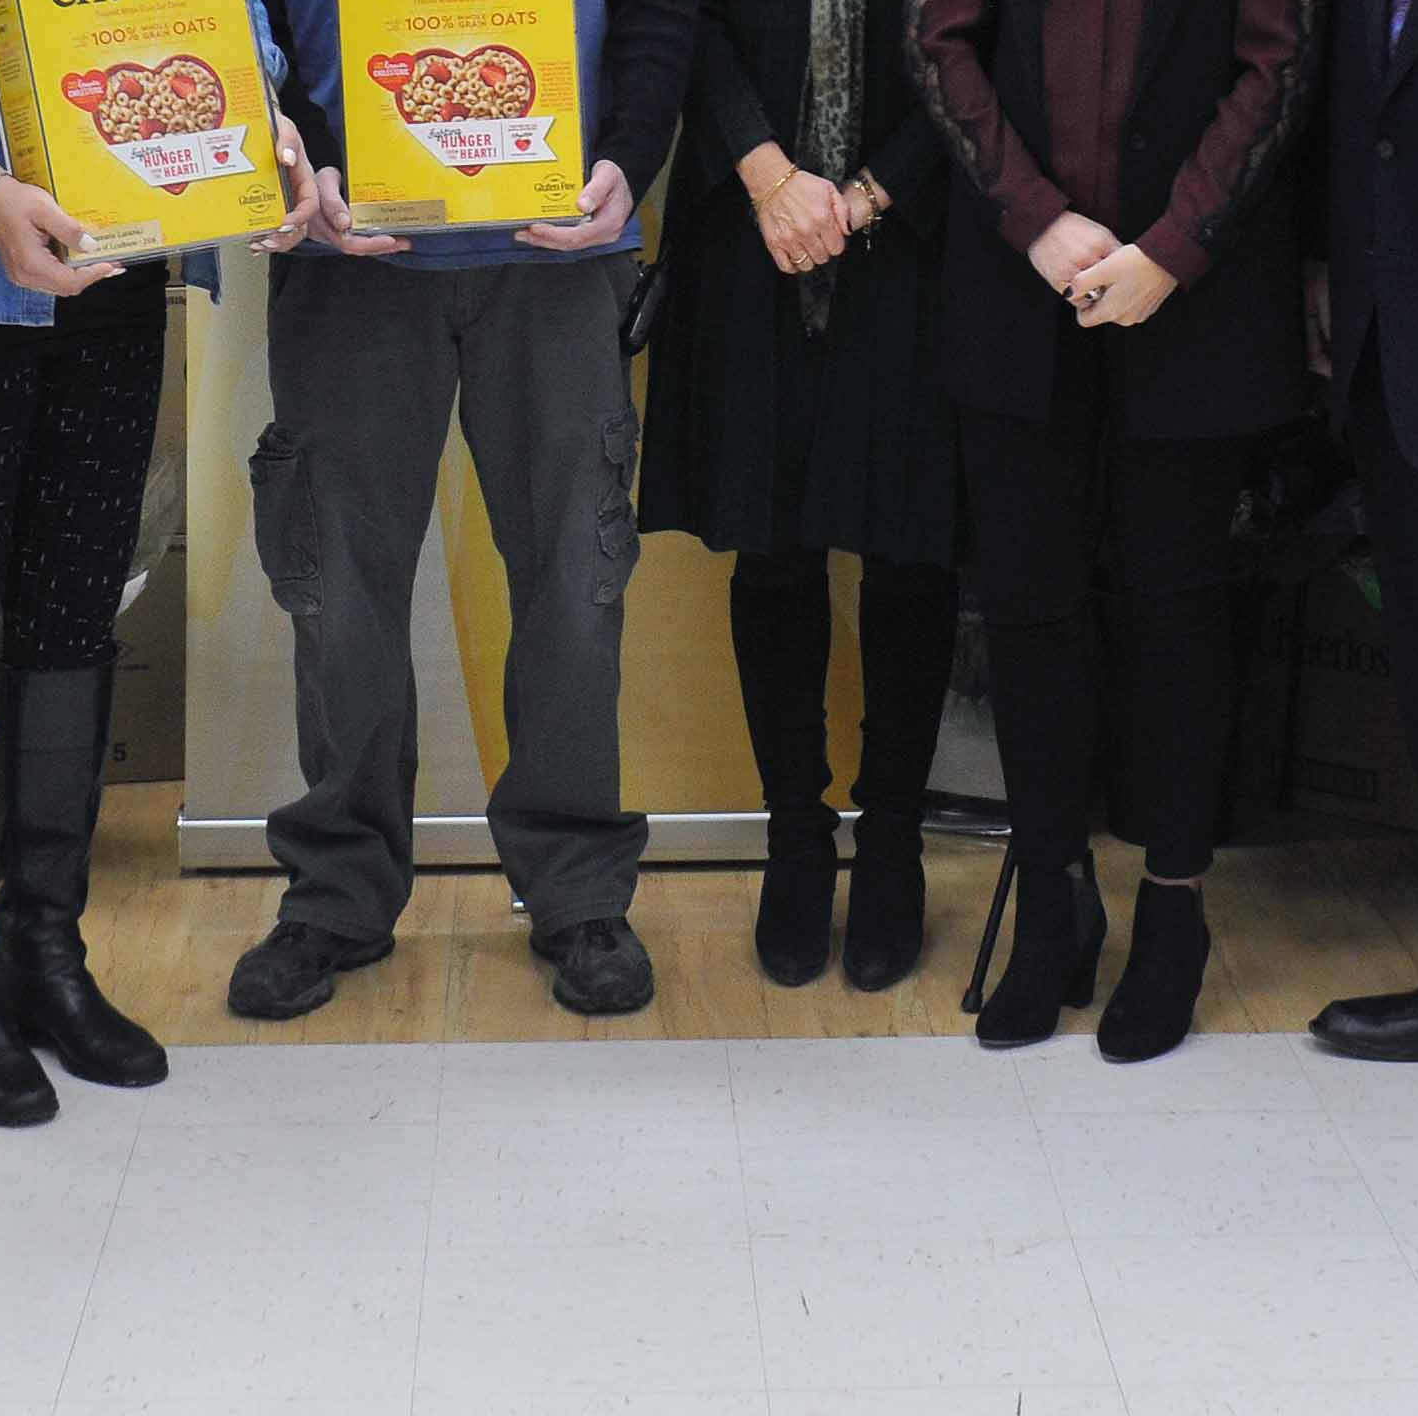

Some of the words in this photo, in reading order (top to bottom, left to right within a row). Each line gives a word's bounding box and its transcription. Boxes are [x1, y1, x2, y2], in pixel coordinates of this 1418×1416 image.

[93, 26, 139, 46] 100%
[173, 16, 218, 36] OATS
[404, 15, 454, 31] 100%
[491, 11, 537, 26] OATS
[440, 134, 493, 149] HUNGER
[144, 148, 193, 169] HUNGER
[460, 149, 498, 160] HEART!
[163, 163, 200, 178] HEART!
[112, 742, 127, 764] 5
